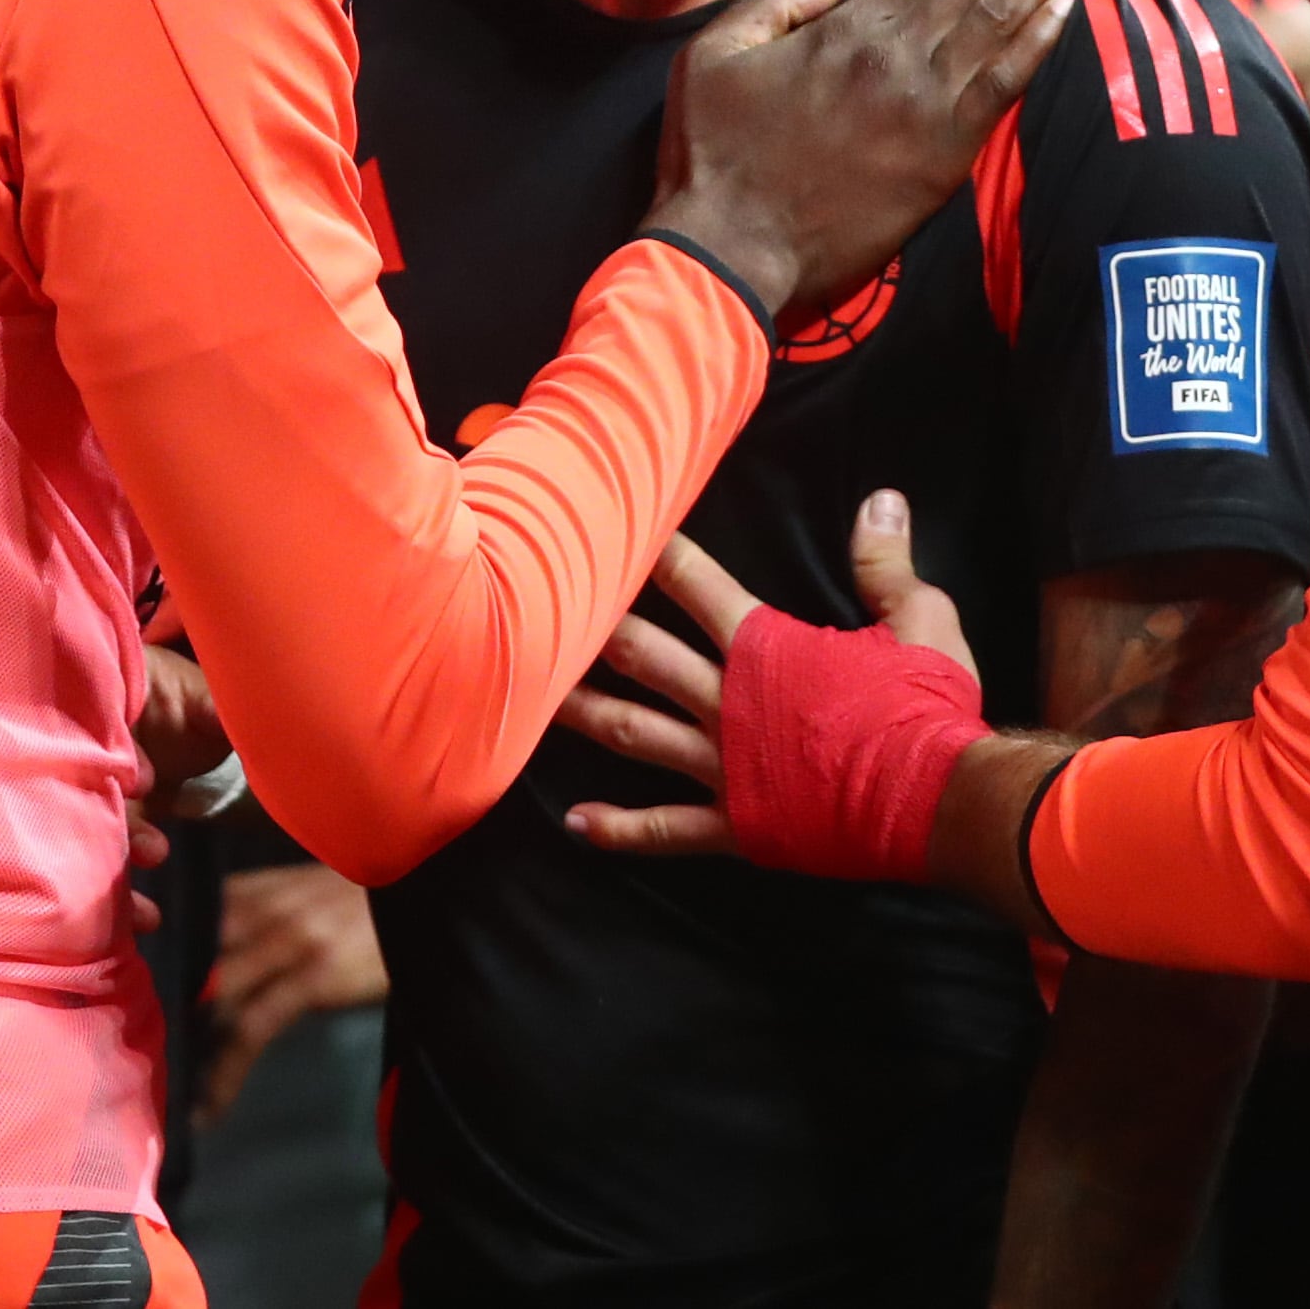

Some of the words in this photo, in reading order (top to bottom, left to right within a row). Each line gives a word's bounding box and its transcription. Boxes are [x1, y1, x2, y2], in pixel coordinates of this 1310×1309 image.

[1144, 274, 1240, 304] FOOTBALL
[1147, 303, 1242, 343] UNITES
[1140, 343, 1183, 378] the
[1186, 342, 1246, 380] World
[1180, 388, 1221, 404] FIFA
